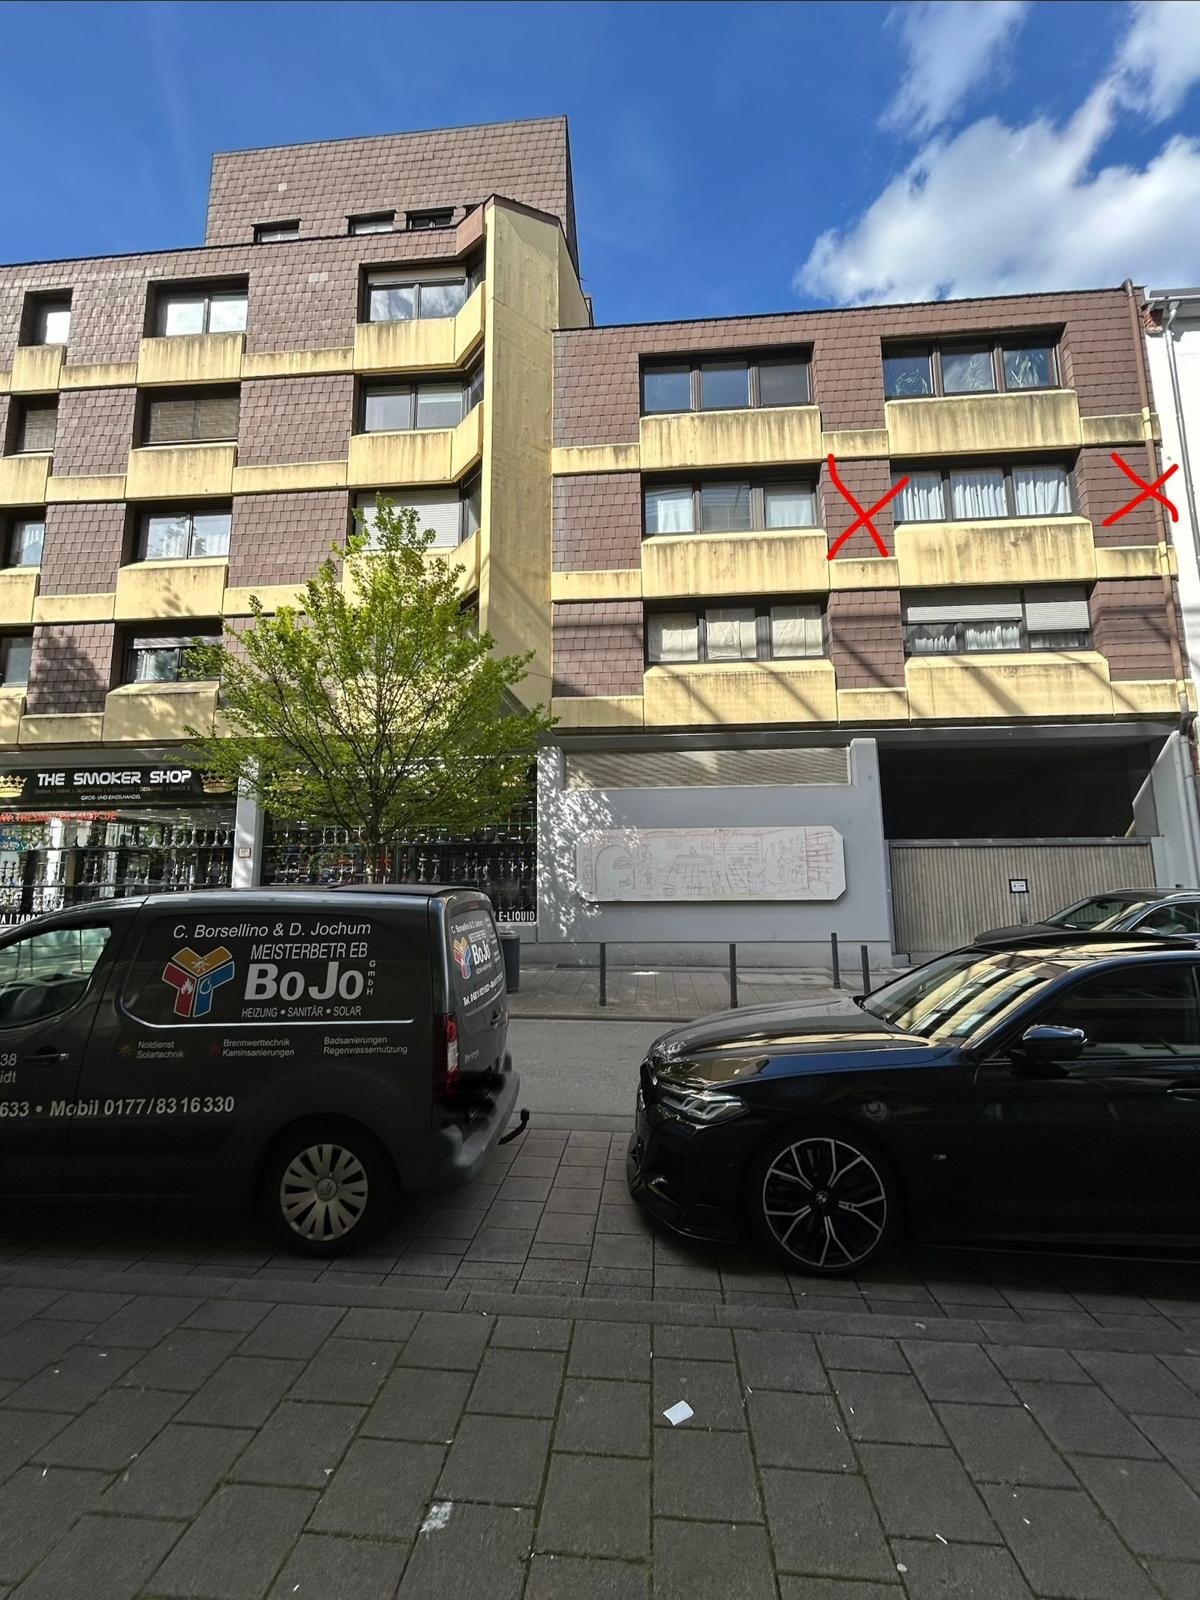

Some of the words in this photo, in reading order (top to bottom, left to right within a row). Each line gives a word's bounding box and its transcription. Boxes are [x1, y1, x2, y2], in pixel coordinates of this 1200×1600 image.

[37, 773, 66, 786] THE
[73, 771, 141, 785] SMOKER
[149, 770, 192, 784] SHOP
[498, 911, 535, 922] E-LIQUID
[173, 925, 188, 939] C.
[194, 923, 268, 938] Borsellino
[273, 923, 284, 936] &
[289, 923, 305, 936] D.
[311, 922, 371, 936] Jochum
[244, 961, 364, 1001] BoJo
[241, 1007, 278, 1018] HEIZUNG
[287, 1005, 323, 1017] SANITÄR
[333, 1005, 362, 1017] SOLAR
[137, 1040, 175, 1049] Notdienst
[223, 1038, 290, 1047] Brennwerttechnik
[324, 1036, 388, 1046] Badsanierungen
[136, 1050, 184, 1059] Solartechnik
[222, 1048, 295, 1058] Kaminsanierungen
[323, 1046, 408, 1056] Regenwassernutzung
[50, 1100, 99, 1117] Mobil
